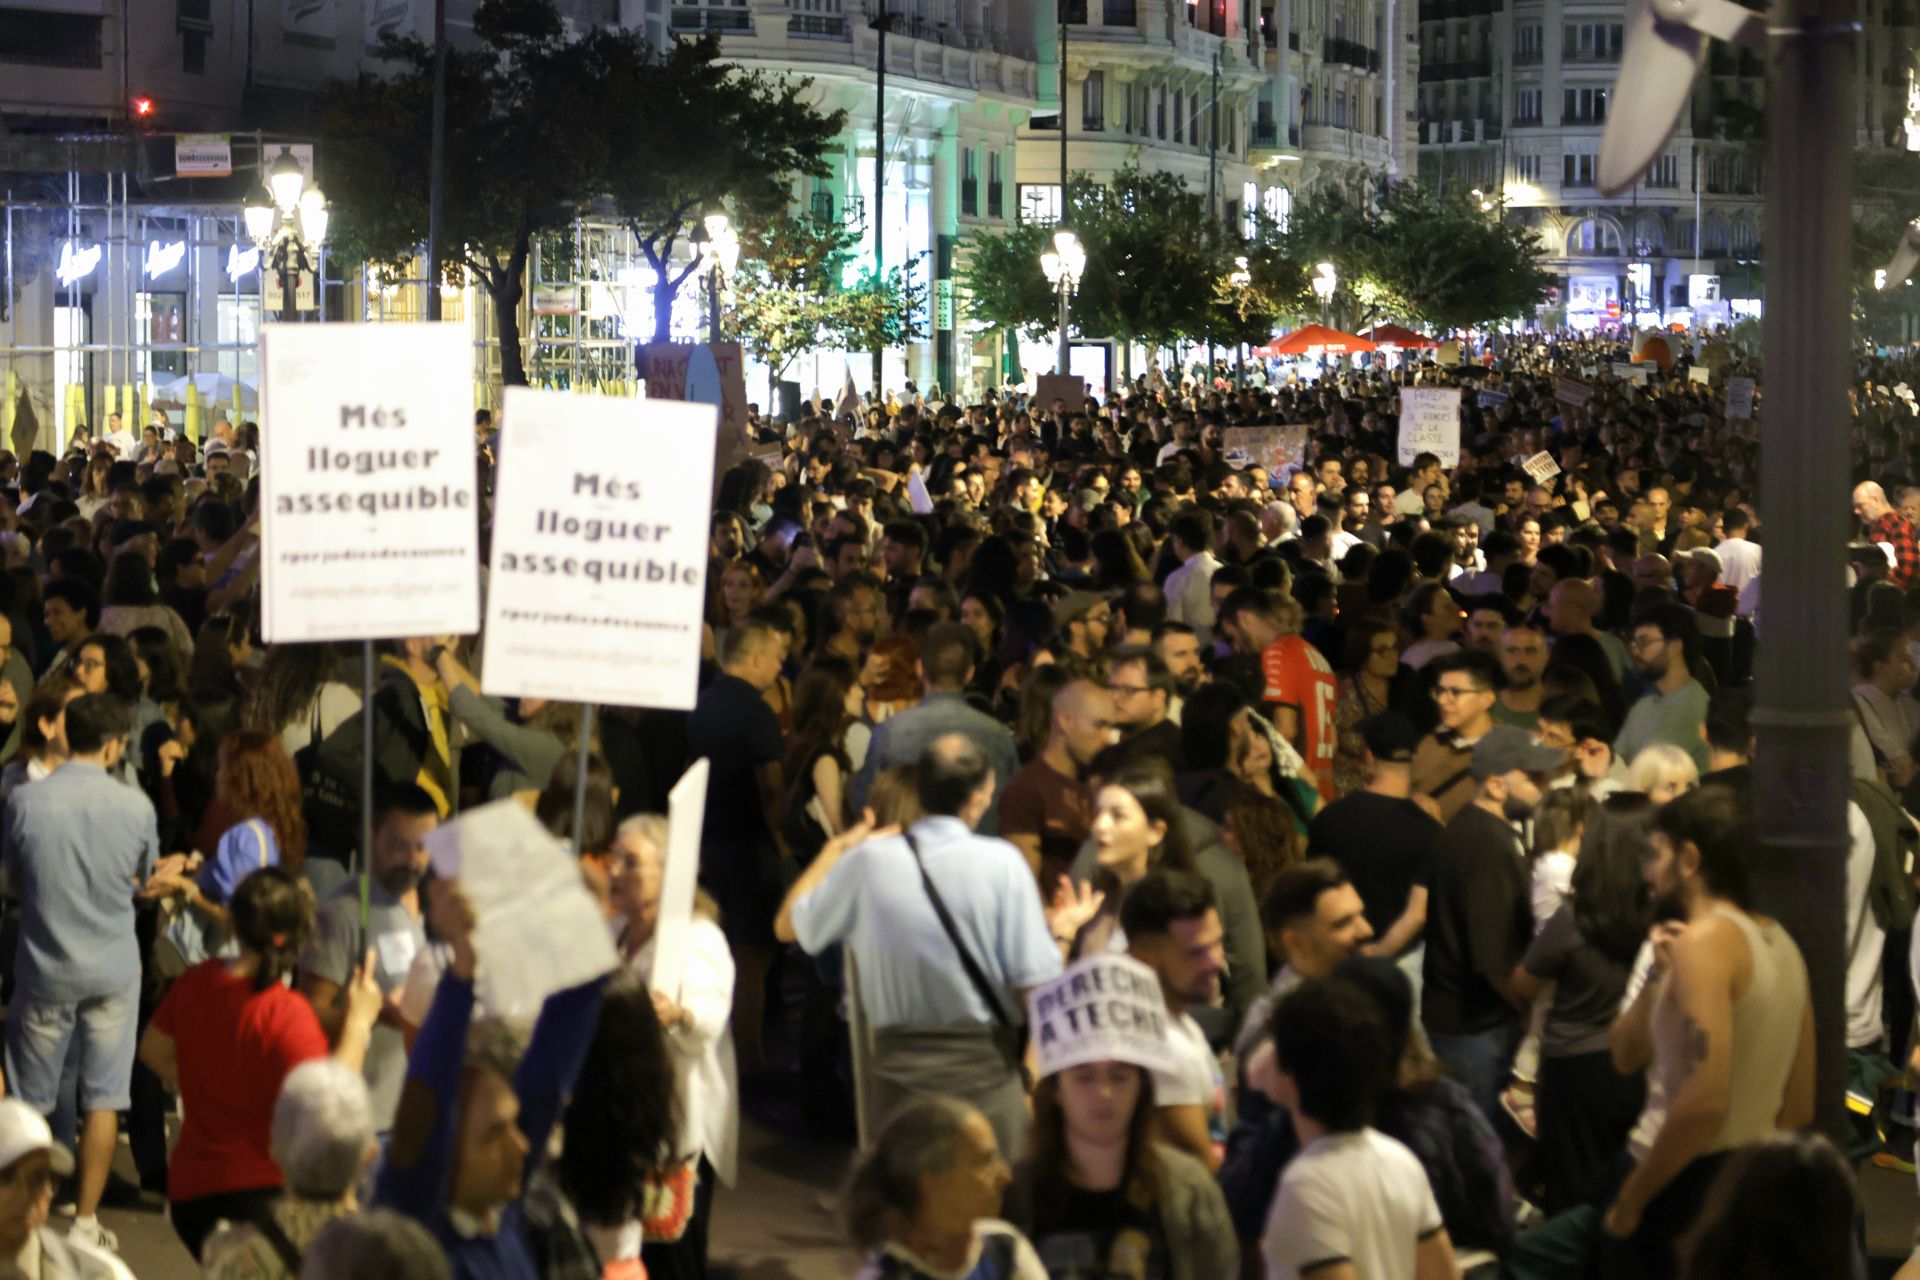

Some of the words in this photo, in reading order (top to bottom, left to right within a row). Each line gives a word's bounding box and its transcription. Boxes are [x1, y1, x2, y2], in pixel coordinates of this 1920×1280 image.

[339, 404, 407, 429] Més
[308, 447, 440, 474] lloguer
[573, 472, 640, 500] Més
[536, 509, 671, 542] lloguer
[1041, 1021, 1057, 1048] A
